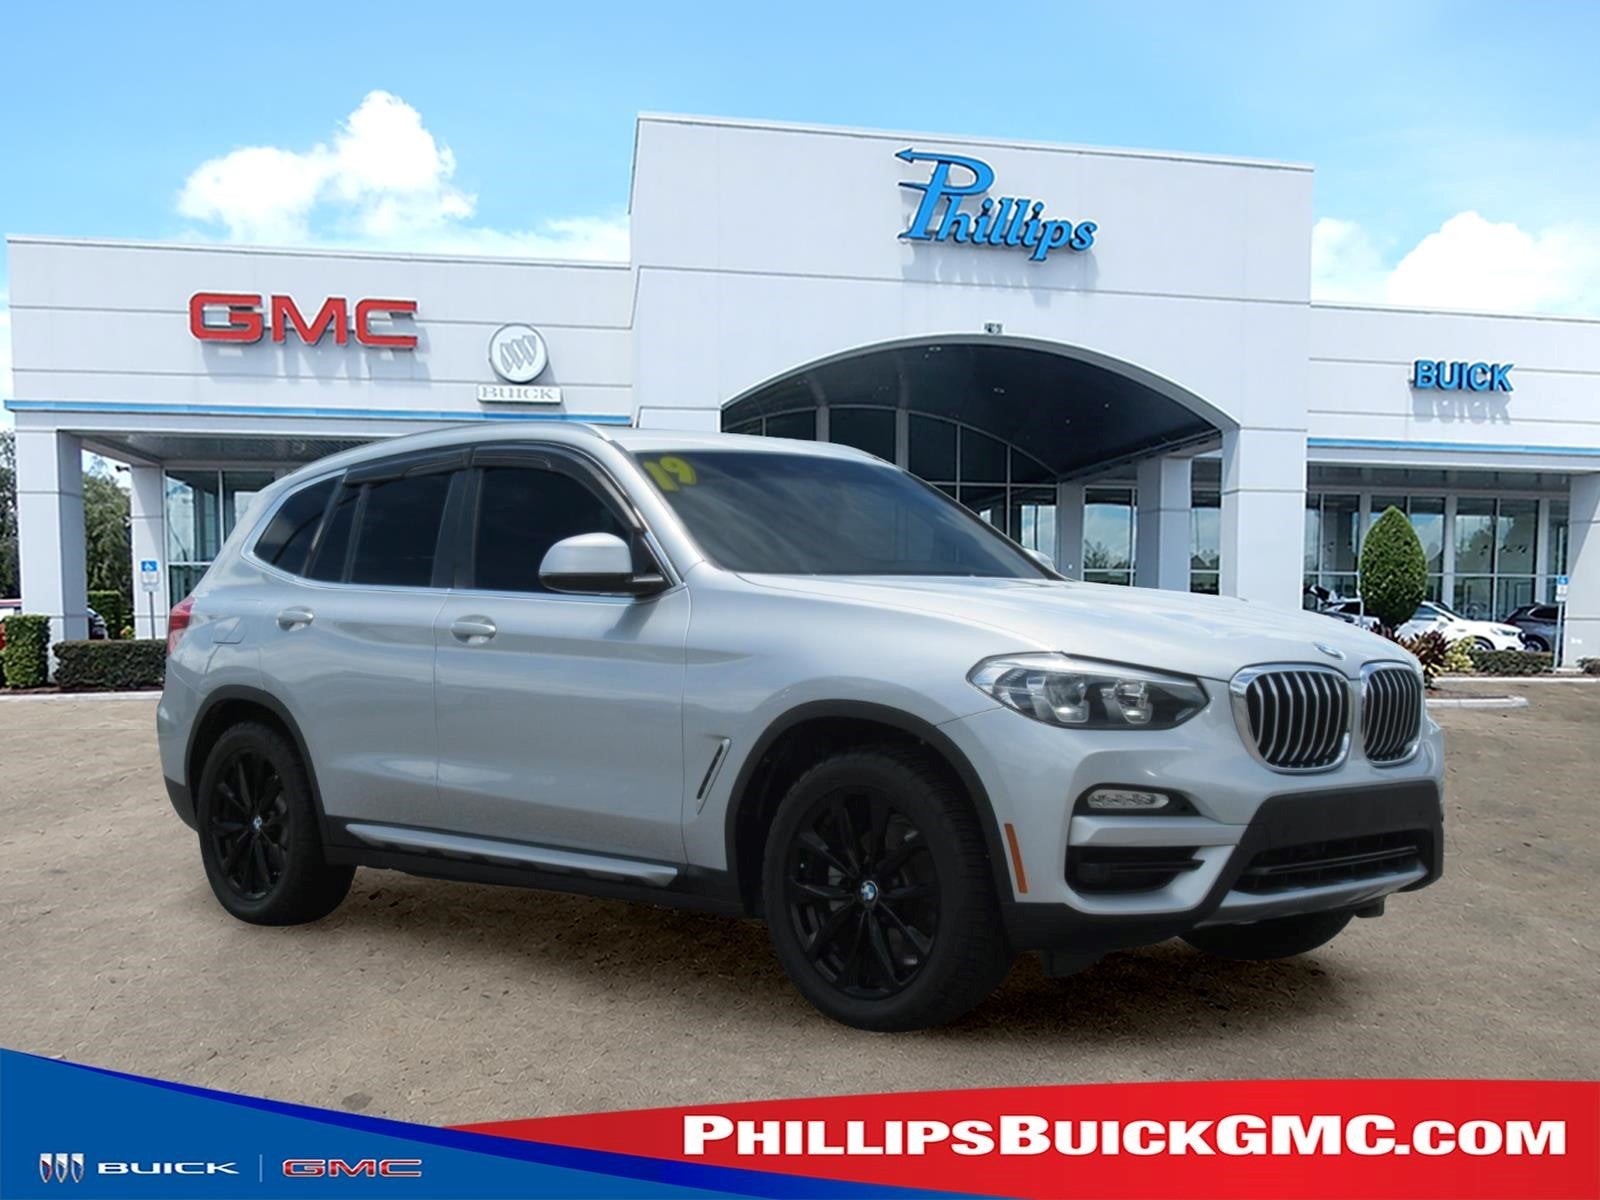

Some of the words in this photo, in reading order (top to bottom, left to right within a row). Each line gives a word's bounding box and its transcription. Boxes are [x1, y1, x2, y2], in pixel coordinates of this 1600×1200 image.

[895, 147, 1098, 262] Phillips
[189, 292, 418, 349] GMC
[482, 386, 555, 399] BUICK
[1413, 359, 1514, 393] BUICK
[643, 456, 697, 491] 19
